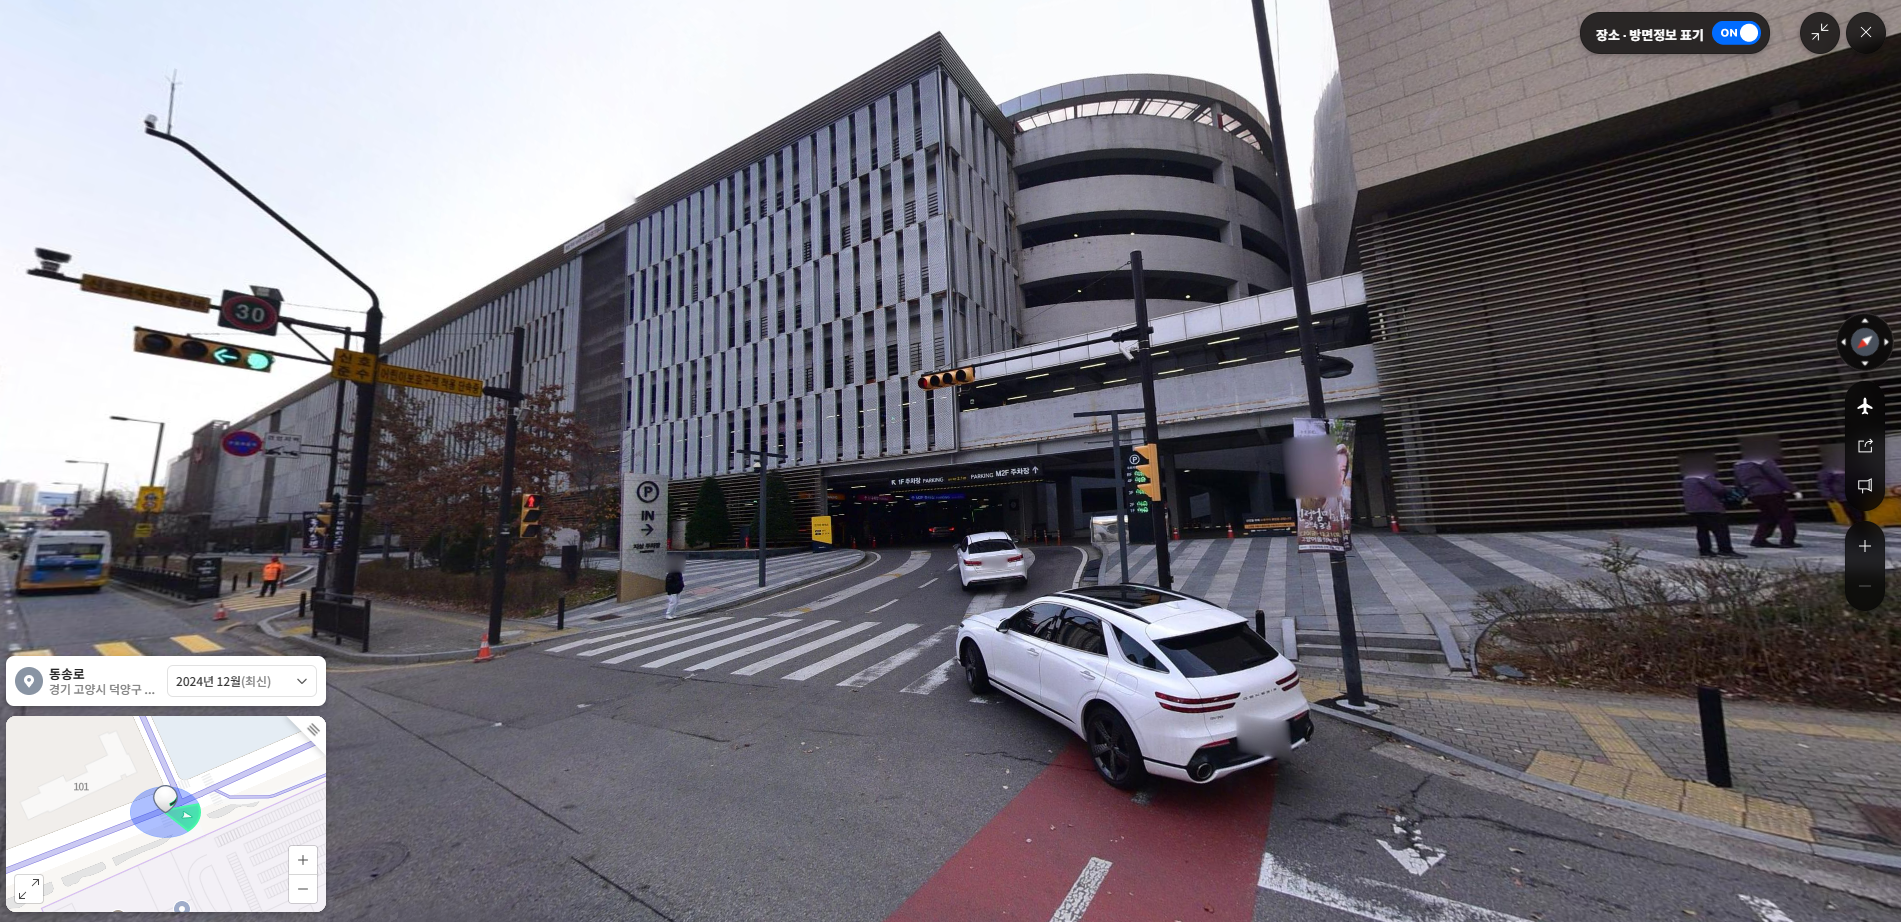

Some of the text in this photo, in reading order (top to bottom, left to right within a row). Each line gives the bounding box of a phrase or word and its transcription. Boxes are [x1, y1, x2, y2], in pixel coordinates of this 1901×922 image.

[235, 304, 265, 322] 30
[380, 367, 440, 388] 어린이보호구역
[971, 467, 1030, 480] PARKING M2F 주차장
[905, 477, 921, 485] 주차장
[923, 476, 944, 484] PARKING
[641, 510, 655, 521] IN
[1242, 687, 1277, 701] GENESIS
